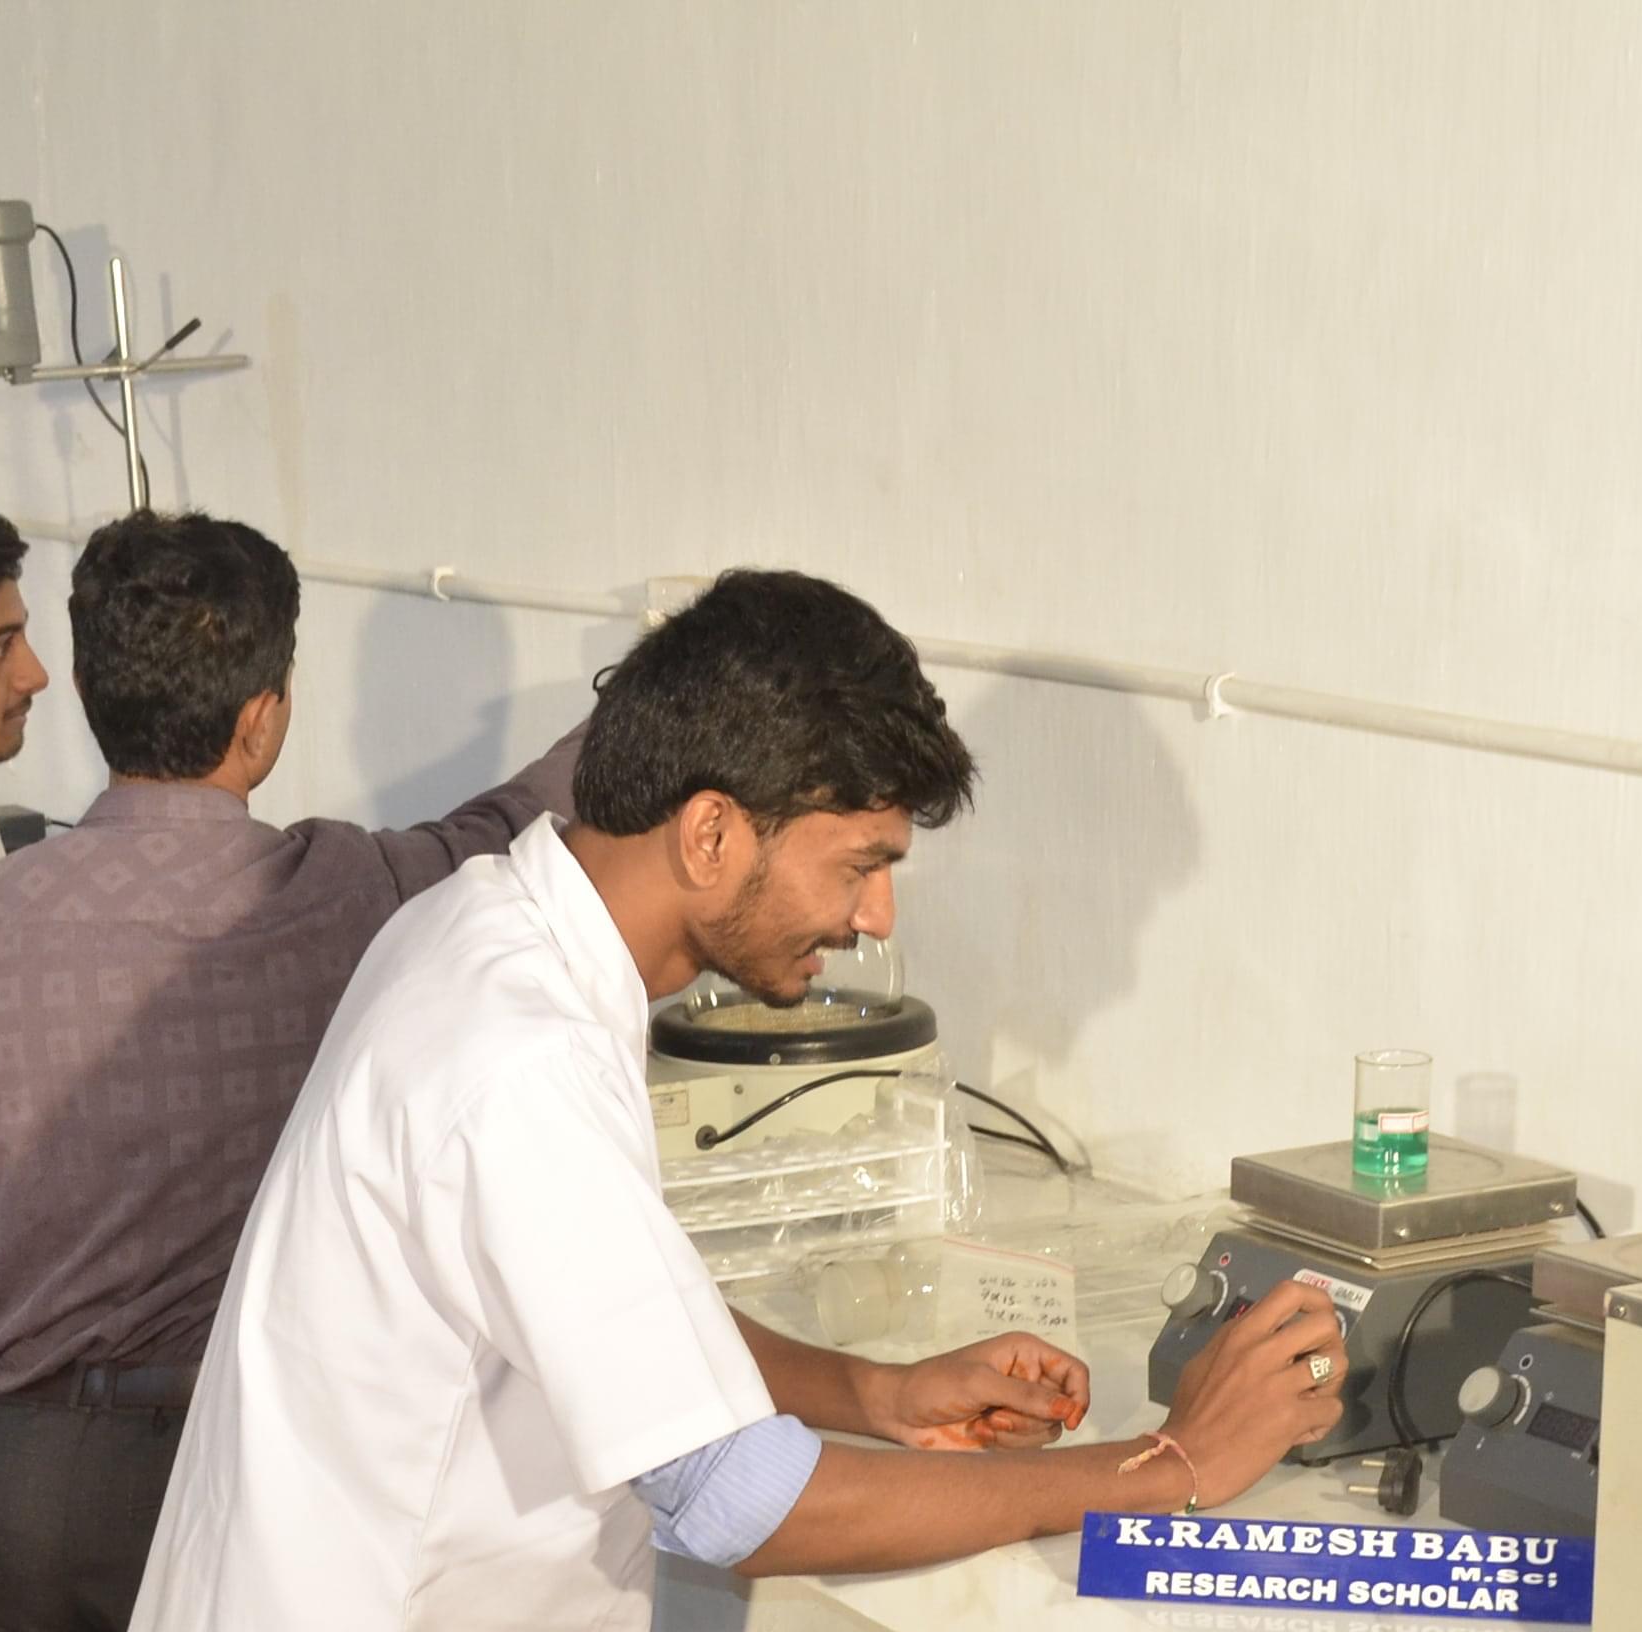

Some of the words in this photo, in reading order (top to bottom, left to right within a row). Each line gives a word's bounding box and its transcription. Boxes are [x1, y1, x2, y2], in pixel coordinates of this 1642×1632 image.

[1115, 1519, 1398, 1559] K.RAMESH
[1410, 1532, 1559, 1565] BABU
[1145, 1571, 1337, 1602] RESEARCH
[1347, 1580, 1520, 1612] SCHOLAR
